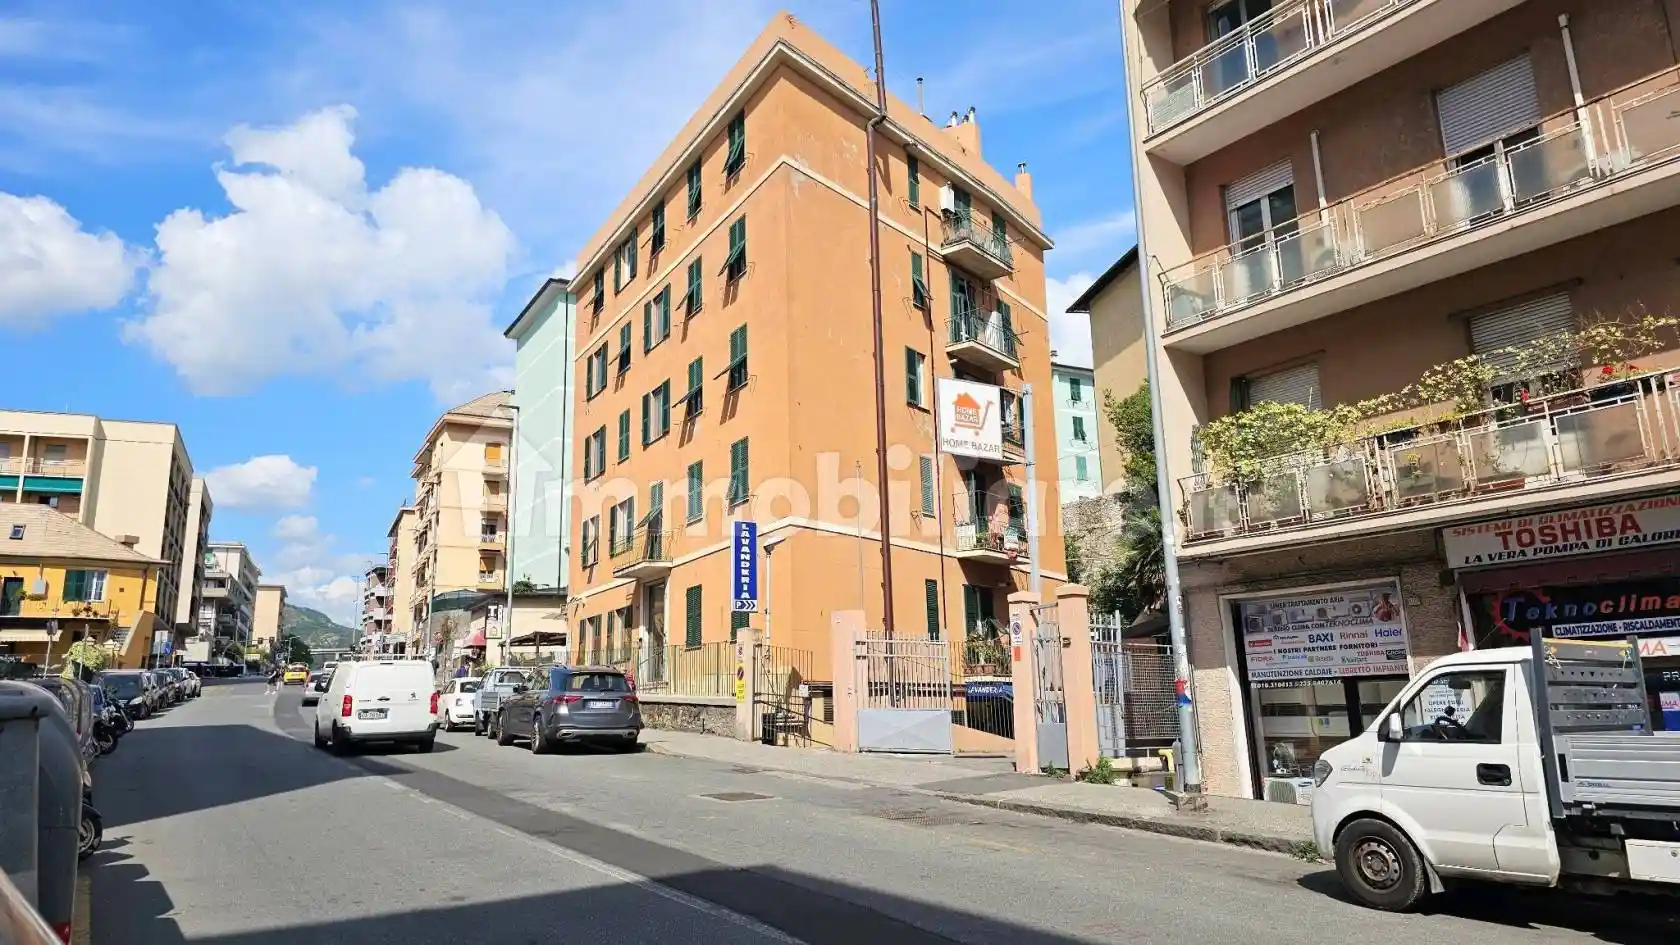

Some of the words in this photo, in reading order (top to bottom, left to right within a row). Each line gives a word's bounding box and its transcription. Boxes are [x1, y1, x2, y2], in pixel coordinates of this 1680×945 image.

[956, 407, 977, 415] HOME
[956, 413, 979, 423] BAZAR
[942, 438, 969, 450] HOME
[971, 441, 1000, 453] BAZAR
[1451, 519, 1512, 538] SISTEMI
[1516, 517, 1534, 529] DI
[1495, 513, 1643, 550] TOSHIBA
[1464, 555, 1483, 565] LA
[1487, 549, 1528, 562] VERA
[1532, 541, 1590, 557] POMPA
[1595, 538, 1613, 549] DI
[740, 523, 751, 599] LAVANDERIA
[1501, 593, 1680, 622] Teknoclima
[1325, 617, 1374, 629] TEKNOCLIMA
[1555, 622, 1619, 637] CLIMATIZZAZIONE
[1308, 632, 1334, 644] BAXI
[1339, 630, 1369, 640] Rinnai
[1278, 646, 1301, 654] NOSTRI
[1339, 642, 1378, 650] FORNITORI
[1356, 649, 1385, 657] TOSHIBA
[1251, 669, 1303, 679] MANUTENZIONE
[1304, 666, 1333, 676] CALDAIE
[1339, 666, 1371, 675] LIBRETTO
